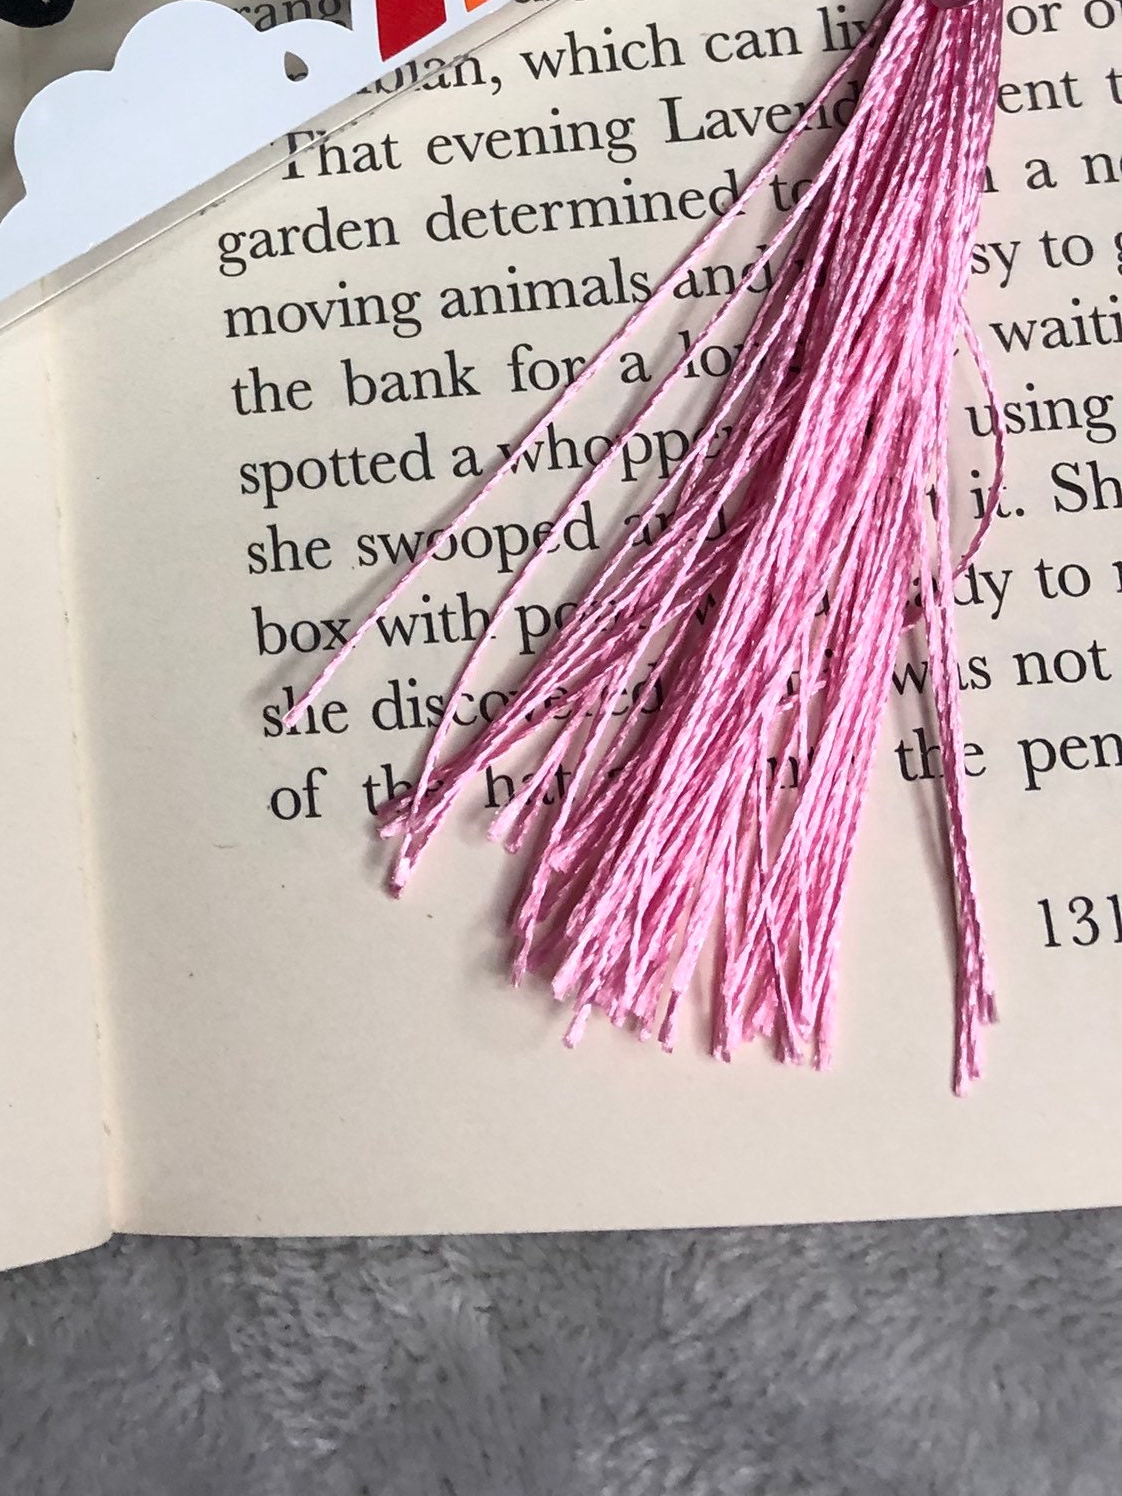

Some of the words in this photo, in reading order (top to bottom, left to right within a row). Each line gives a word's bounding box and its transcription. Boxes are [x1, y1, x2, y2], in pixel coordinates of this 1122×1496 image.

[519, 22, 686, 80] which
[705, 26, 803, 63] can
[426, 107, 638, 165] evening
[218, 205, 401, 278] garden
[425, 163, 740, 242] determined
[223, 280, 422, 339] moving
[439, 256, 653, 320] animals
[230, 366, 313, 416] the
[340, 349, 482, 407] bank
[239, 431, 436, 510] spotted
[963, 382, 1118, 446] using
[247, 523, 333, 575] she
[250, 605, 353, 657] box
[1033, 558, 1091, 600] to
[1012, 639, 1113, 686] not
[1037, 893, 1122, 948] 131
